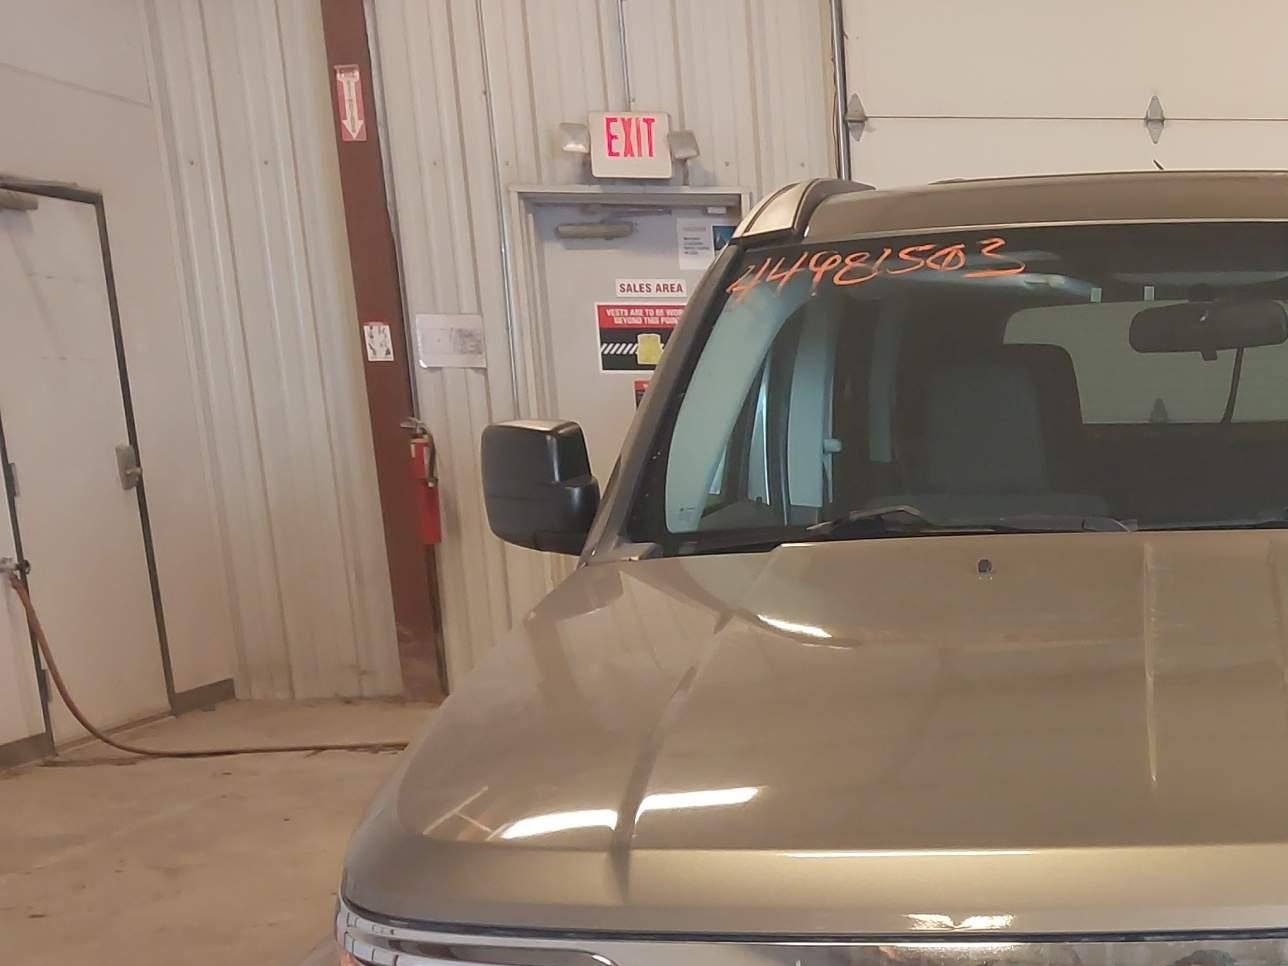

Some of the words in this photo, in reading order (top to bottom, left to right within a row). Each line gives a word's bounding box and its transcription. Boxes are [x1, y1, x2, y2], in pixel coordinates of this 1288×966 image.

[605, 117, 655, 157] EXIT
[619, 283, 652, 293] SALES
[655, 283, 684, 293] AREA
